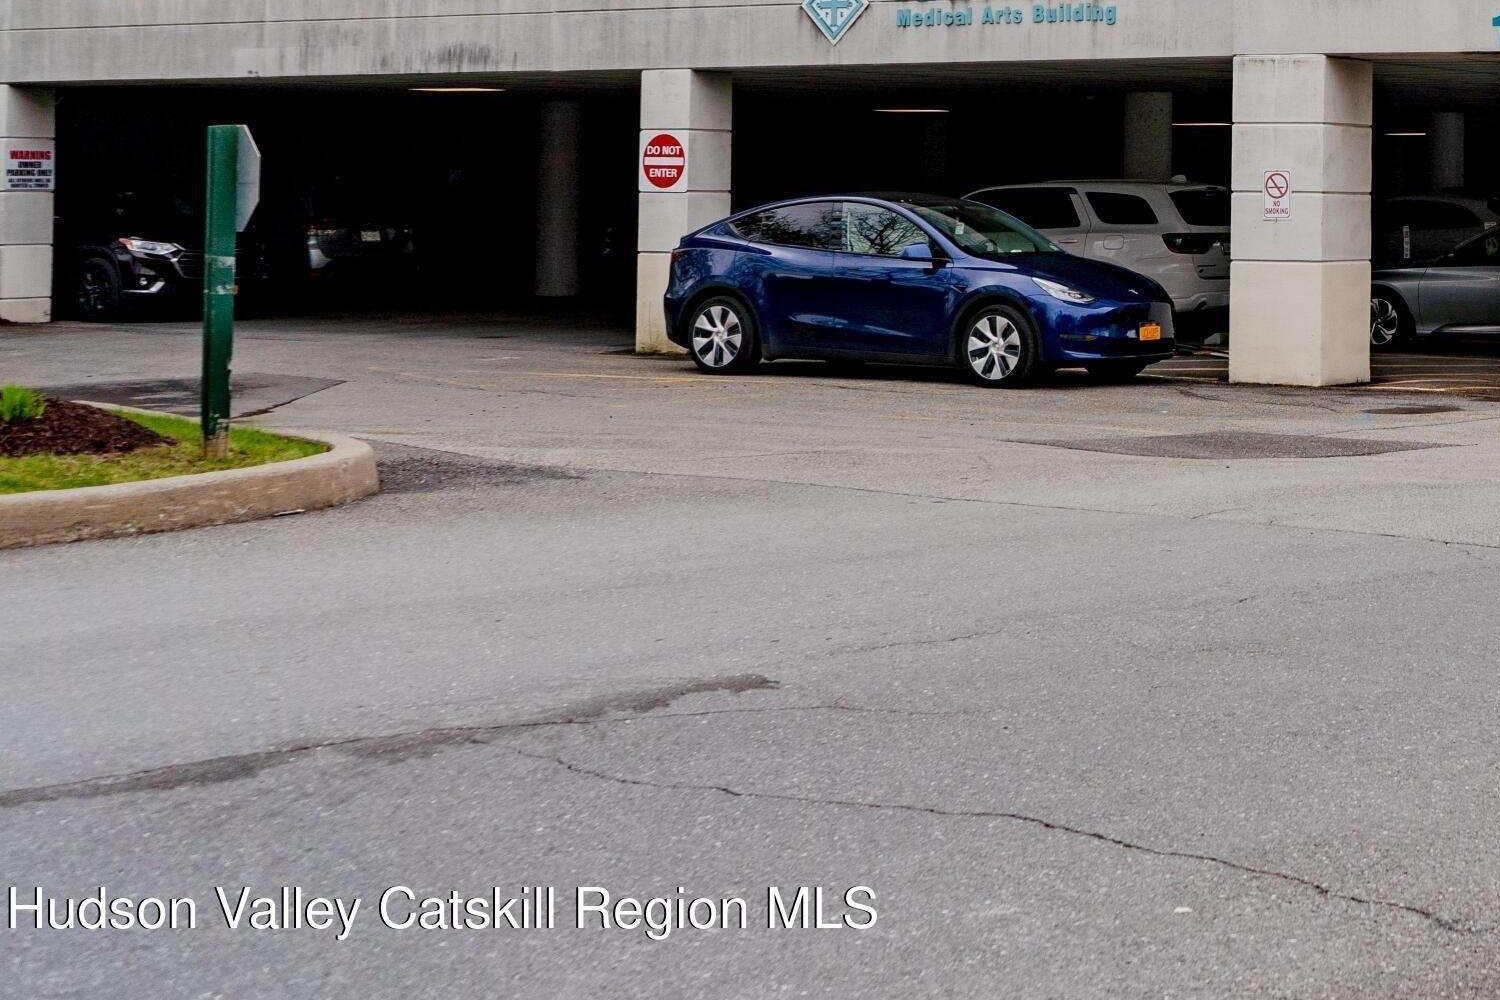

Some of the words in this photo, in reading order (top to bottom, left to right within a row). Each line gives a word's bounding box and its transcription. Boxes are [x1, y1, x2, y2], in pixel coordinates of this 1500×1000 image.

[896, 7, 973, 27] Medical
[982, 5, 1023, 24] Arts
[1032, 3, 1117, 25] Building
[646, 145, 660, 155] DO
[662, 145, 681, 155] NOT
[649, 168, 677, 178] ENTER
[1265, 207, 1289, 215] SMOKING
